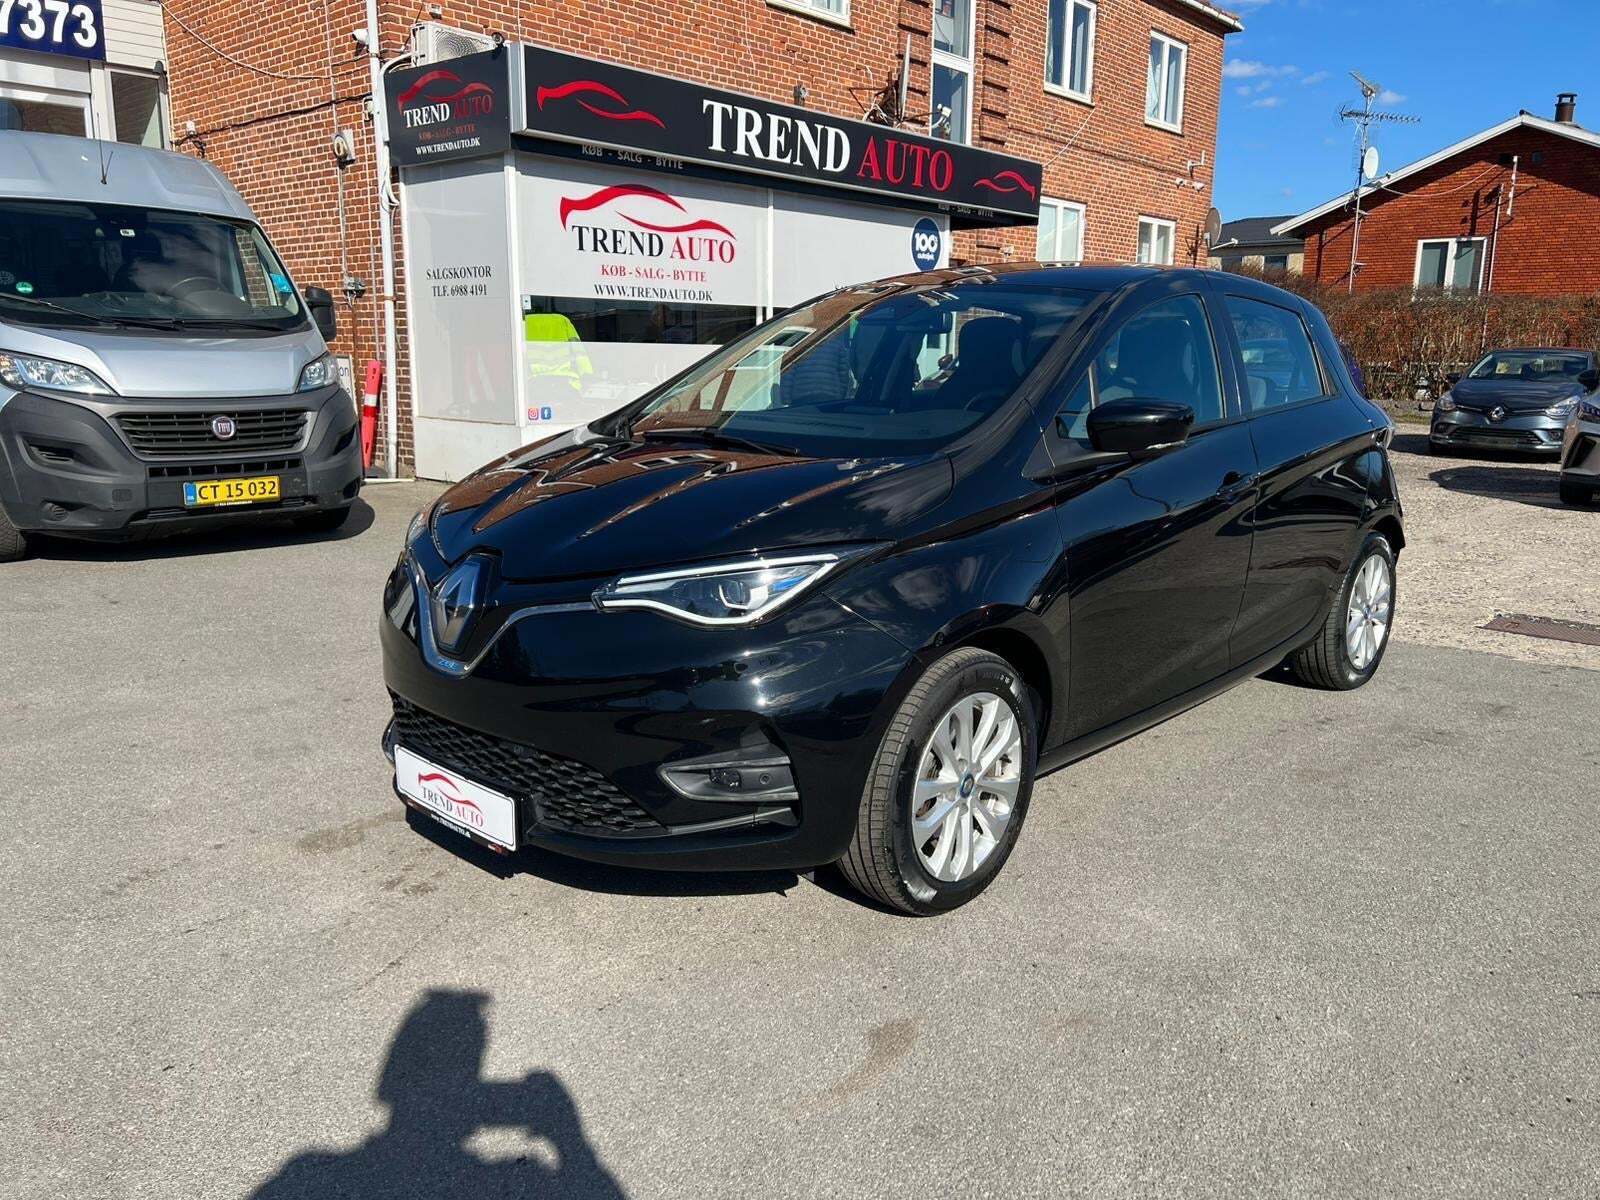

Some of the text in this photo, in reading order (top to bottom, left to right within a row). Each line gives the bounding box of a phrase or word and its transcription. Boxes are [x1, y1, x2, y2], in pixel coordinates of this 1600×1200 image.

[404, 94, 493, 128] TREND AUTO
[416, 137, 481, 155] WWW.TRENDAUTO.DK
[703, 100, 953, 192] TREND AUTO
[572, 225, 735, 264] TREND AUTO
[426, 265, 492, 280] SALGSKONTOR
[635, 266, 665, 280] SALG
[673, 270, 707, 283] BYTTE
[432, 285, 449, 297] TLF.
[470, 283, 487, 296] 4191
[594, 284, 713, 302] WWW.TRENDAUTO.DK
[198, 480, 277, 500] CT 15 032
[422, 787, 453, 812] TREND
[455, 804, 484, 828] AUTO
